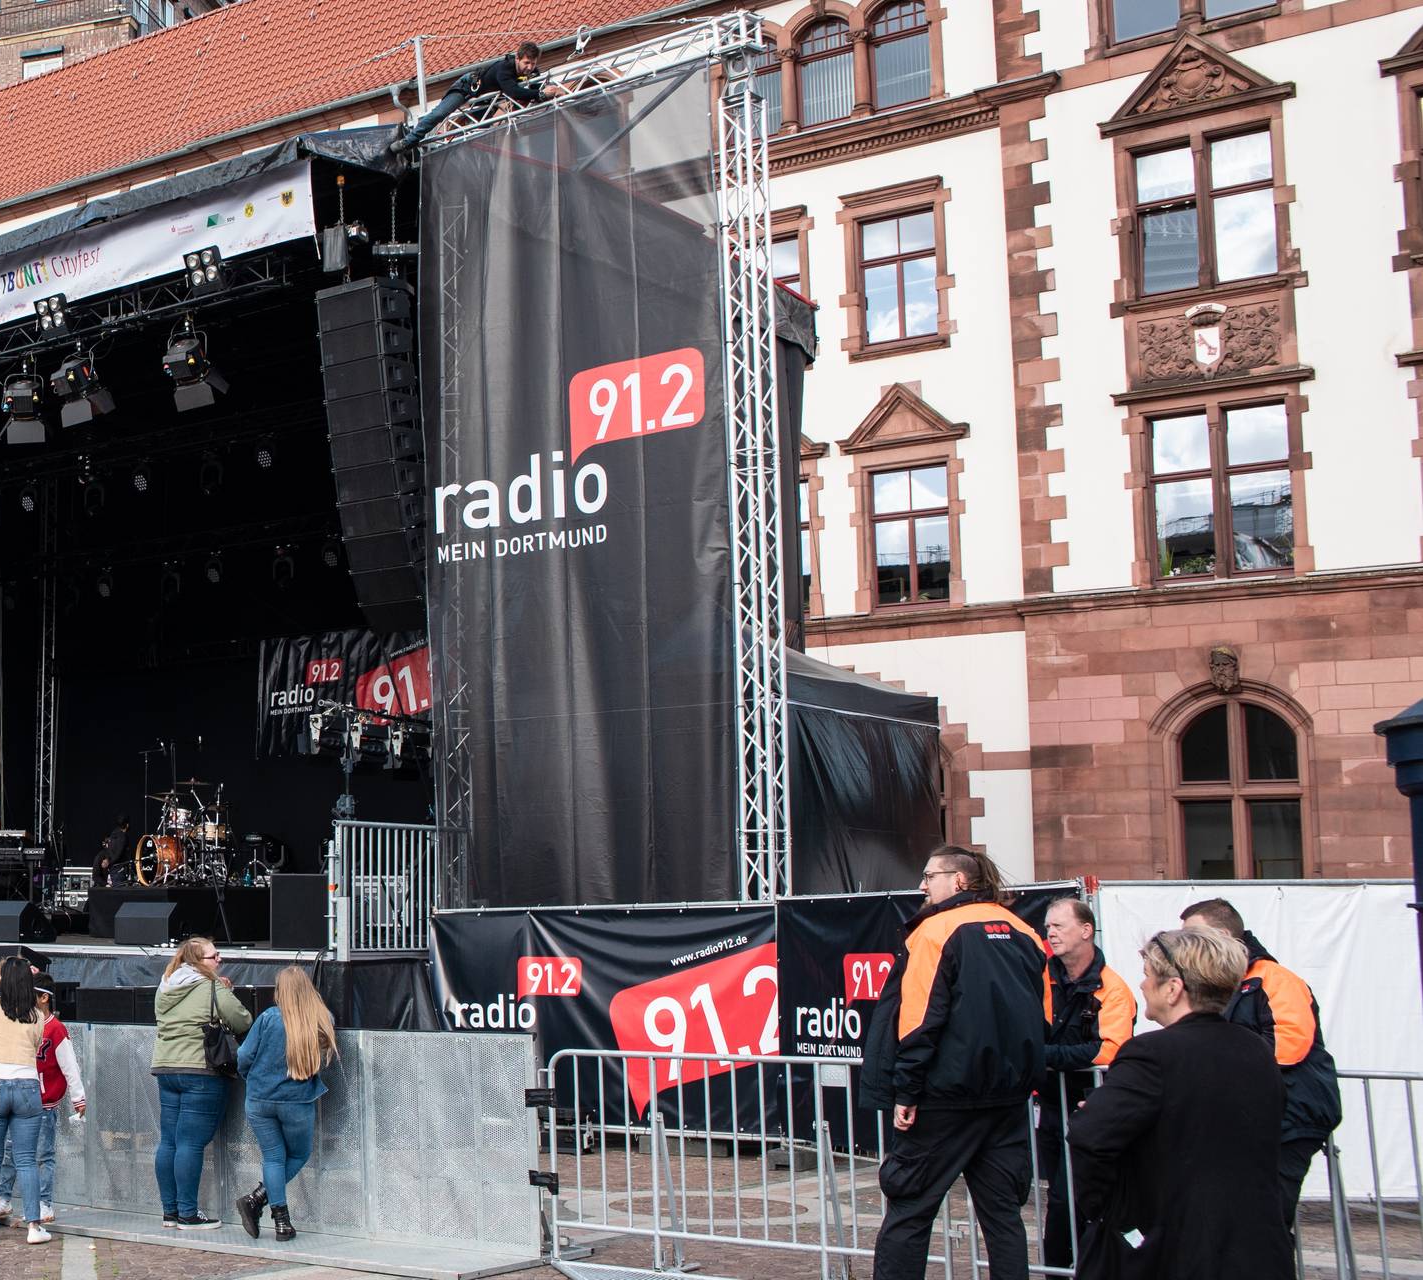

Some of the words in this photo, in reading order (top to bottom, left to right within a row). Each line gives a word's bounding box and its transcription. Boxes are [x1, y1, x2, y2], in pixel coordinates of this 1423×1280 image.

[51, 247, 100, 278] Cityfest
[589, 363, 695, 440] 91.2
[435, 450, 608, 534] radio
[437, 540, 486, 563] MEIN
[495, 524, 608, 557] DORTMUND
[312, 662, 339, 682] 91.2
[270, 684, 315, 707] radio
[373, 665, 429, 715] 91.
[270, 707, 282, 715] MEIN
[283, 705, 313, 714] DORTMUND
[670, 935, 748, 966] www.radio912.de
[527, 963, 576, 994] 91.2
[455, 994, 537, 1029] radio
[644, 965, 779, 1081] 91.2
[796, 998, 862, 1040] radio
[797, 1042, 816, 1054] MEIN
[819, 1044, 862, 1057] DORTMUND
